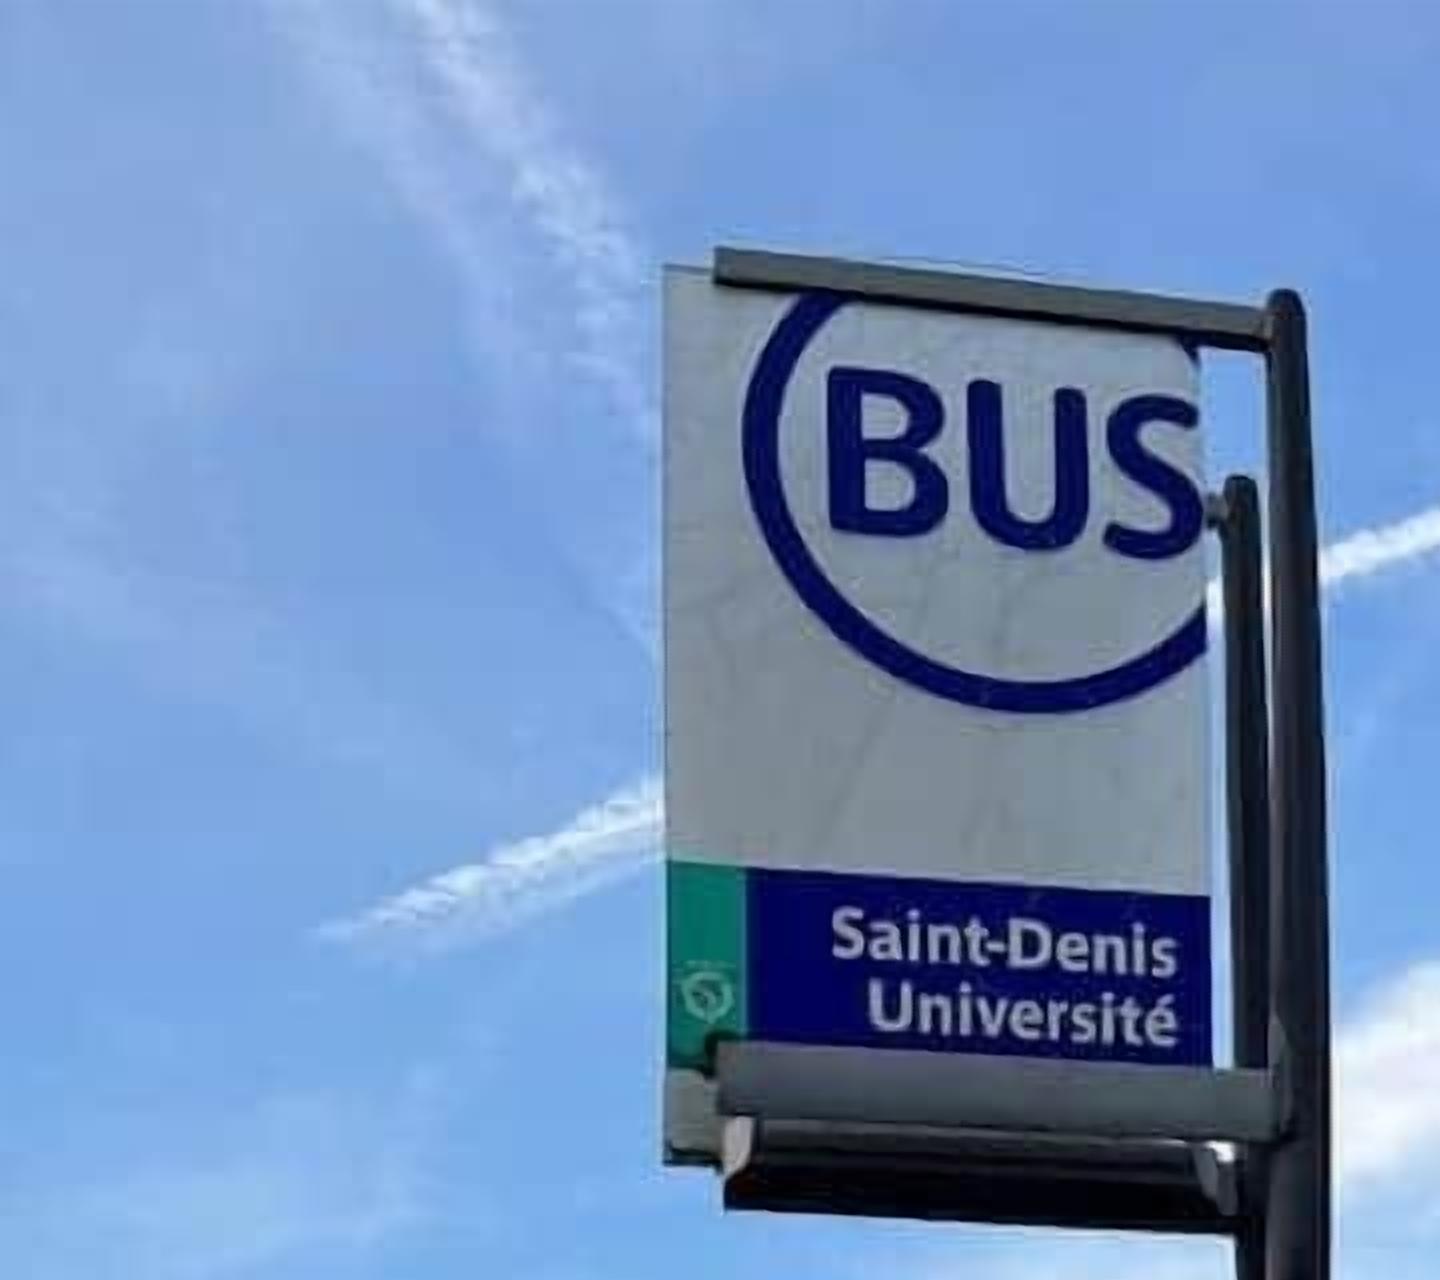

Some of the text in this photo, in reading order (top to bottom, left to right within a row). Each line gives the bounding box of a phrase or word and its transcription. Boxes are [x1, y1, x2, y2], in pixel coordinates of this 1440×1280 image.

[826, 366, 1204, 561] BUS
[831, 904, 1179, 979] Saint-Denis
[867, 976, 1179, 1048] Université
